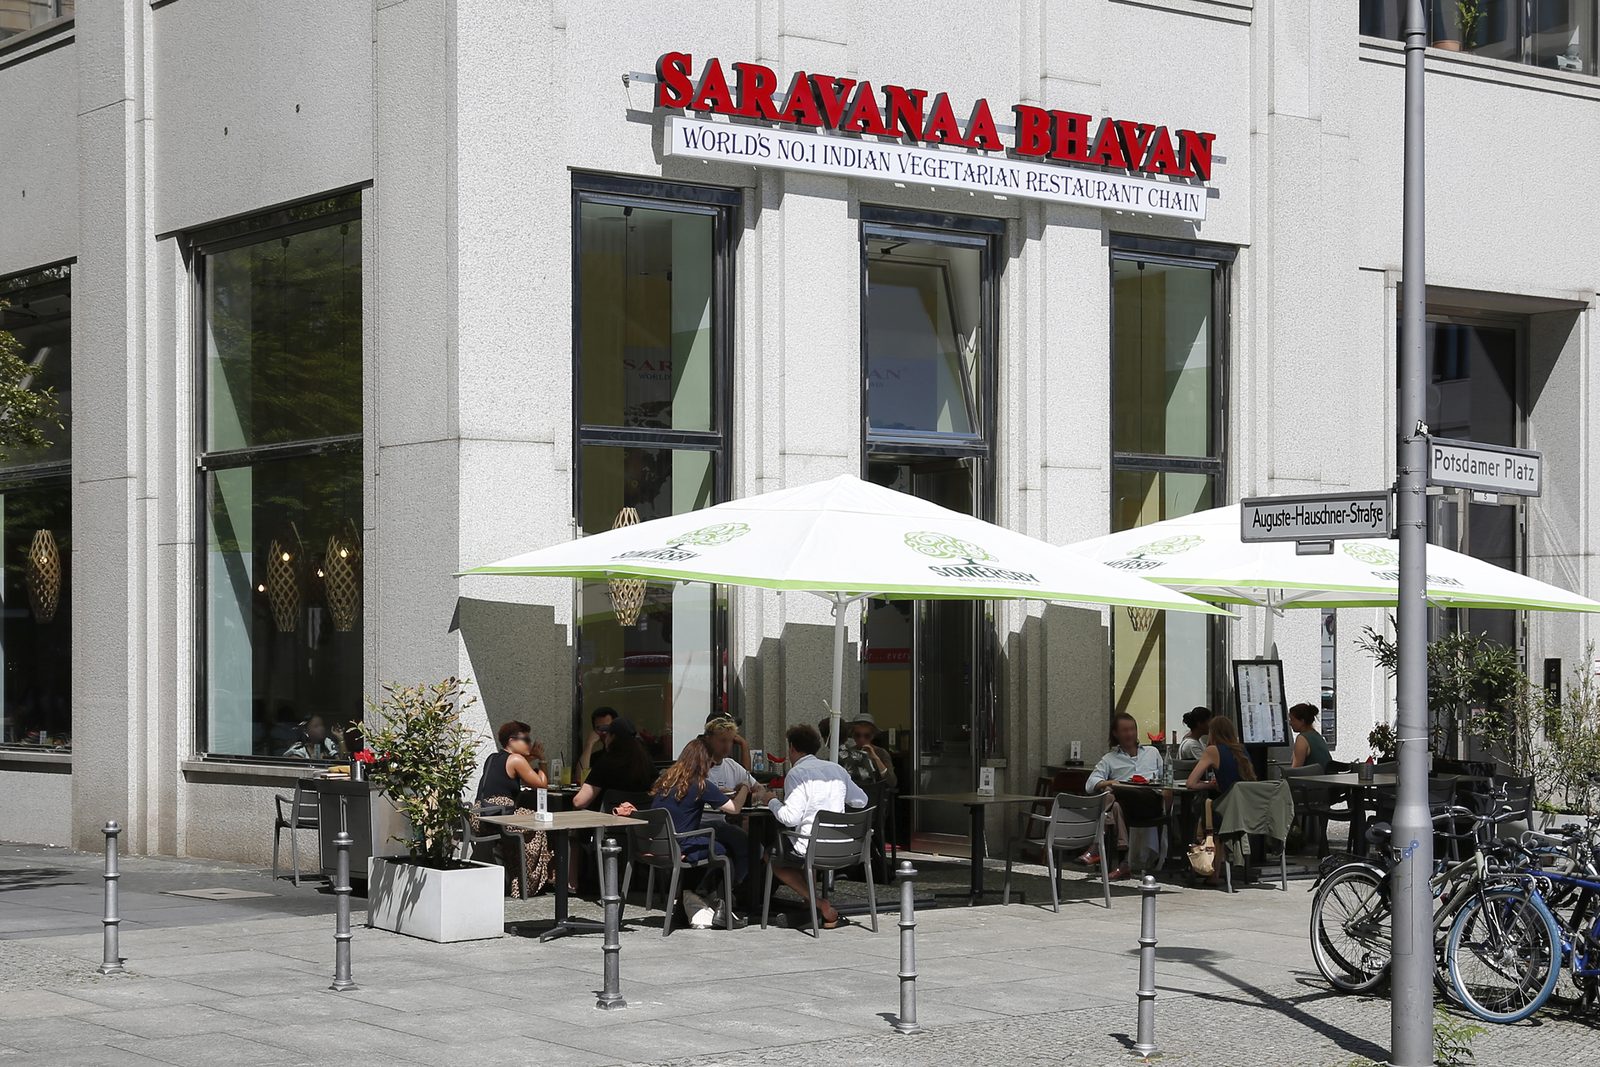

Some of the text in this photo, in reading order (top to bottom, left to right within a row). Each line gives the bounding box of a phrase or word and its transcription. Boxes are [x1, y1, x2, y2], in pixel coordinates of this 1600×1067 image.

[657, 52, 1216, 181] SARAVANAA BHAVAN
[682, 125, 1200, 213] WORLD'S NO.1 INDIAN VEGETARIAN RESTAURANT CHAIN
[1434, 448, 1535, 482] Potsdamer Platz
[1252, 501, 1384, 533] Auguste-Hauschner-Straße
[928, 565, 1040, 583] SOMERSBY
